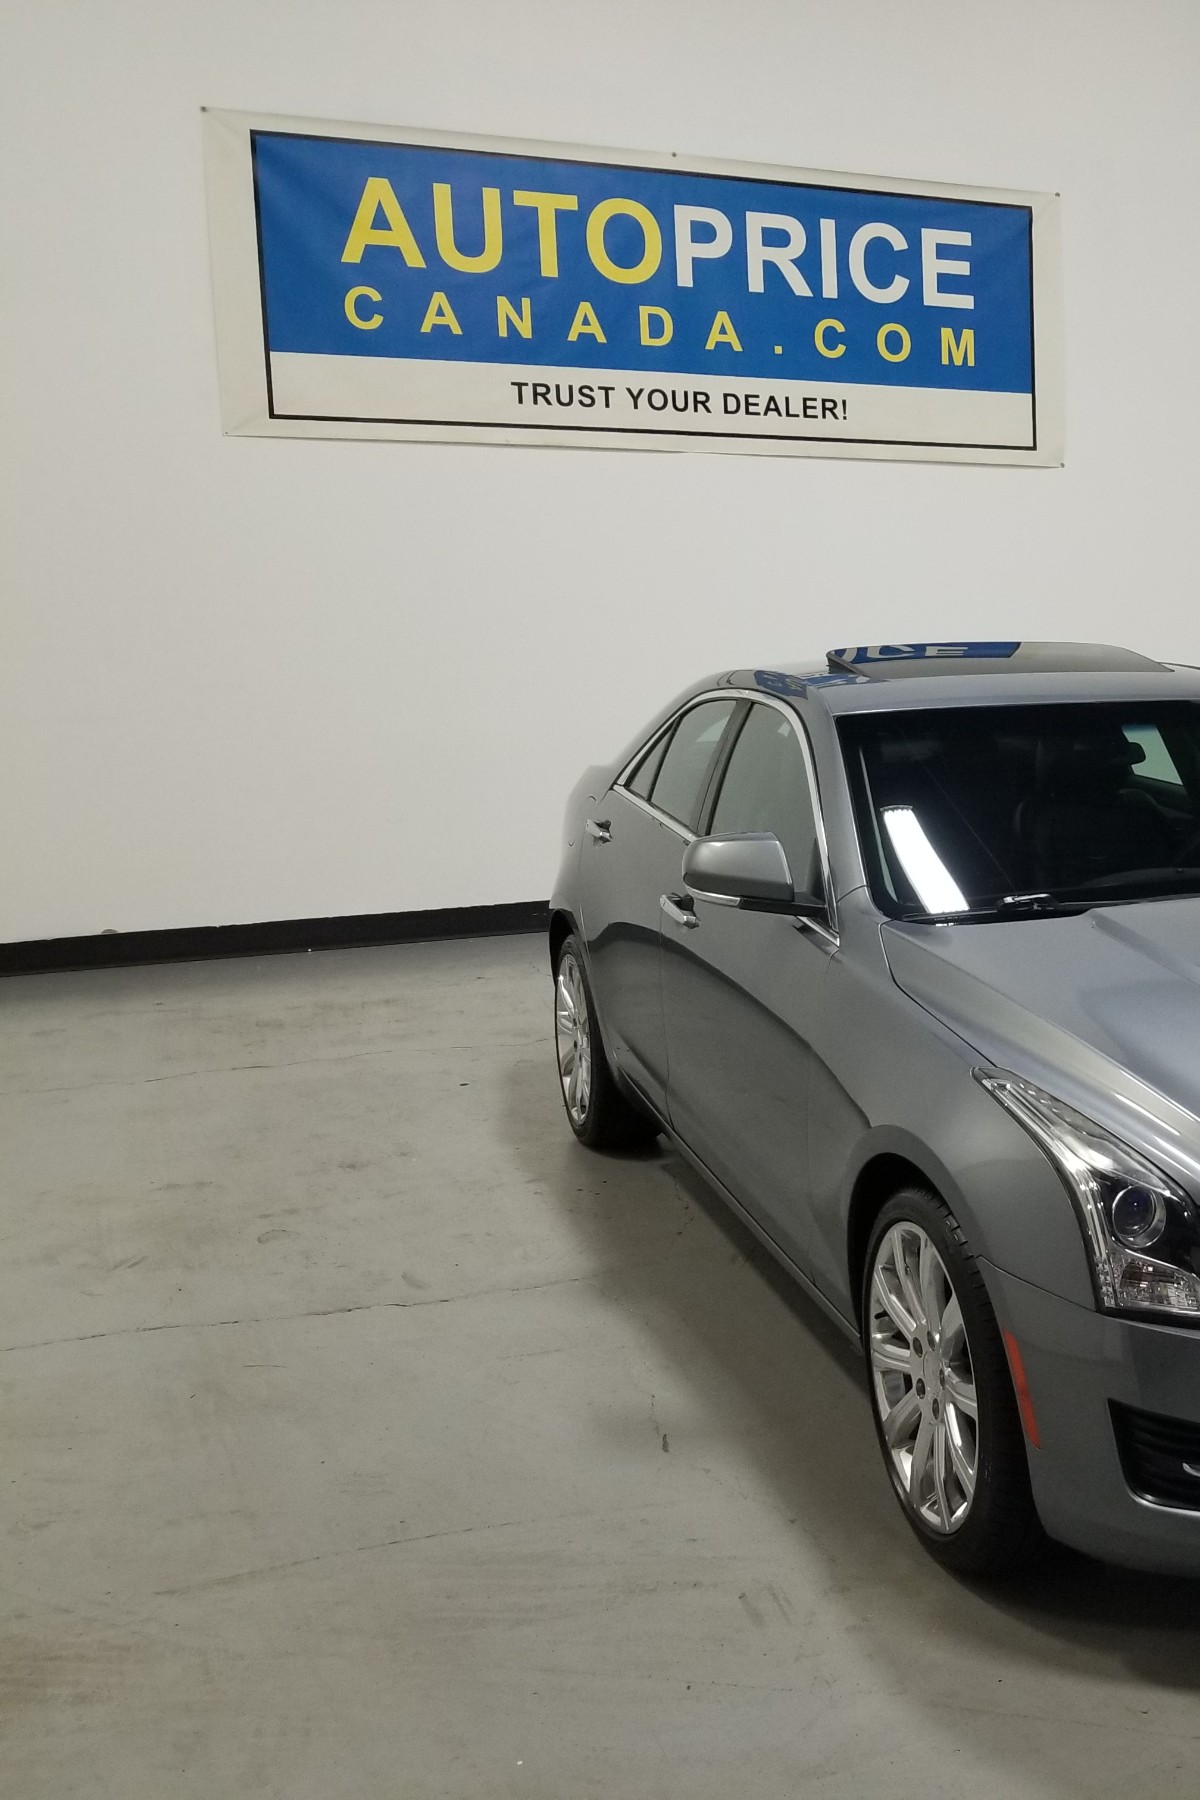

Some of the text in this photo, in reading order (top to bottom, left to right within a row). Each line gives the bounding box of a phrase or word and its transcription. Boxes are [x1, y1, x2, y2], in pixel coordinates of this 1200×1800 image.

[341, 176, 975, 310] AUTOPRICE
[344, 285, 975, 367] CANADA.COM
[510, 381, 848, 421] TRUST YOUR DEALER!
